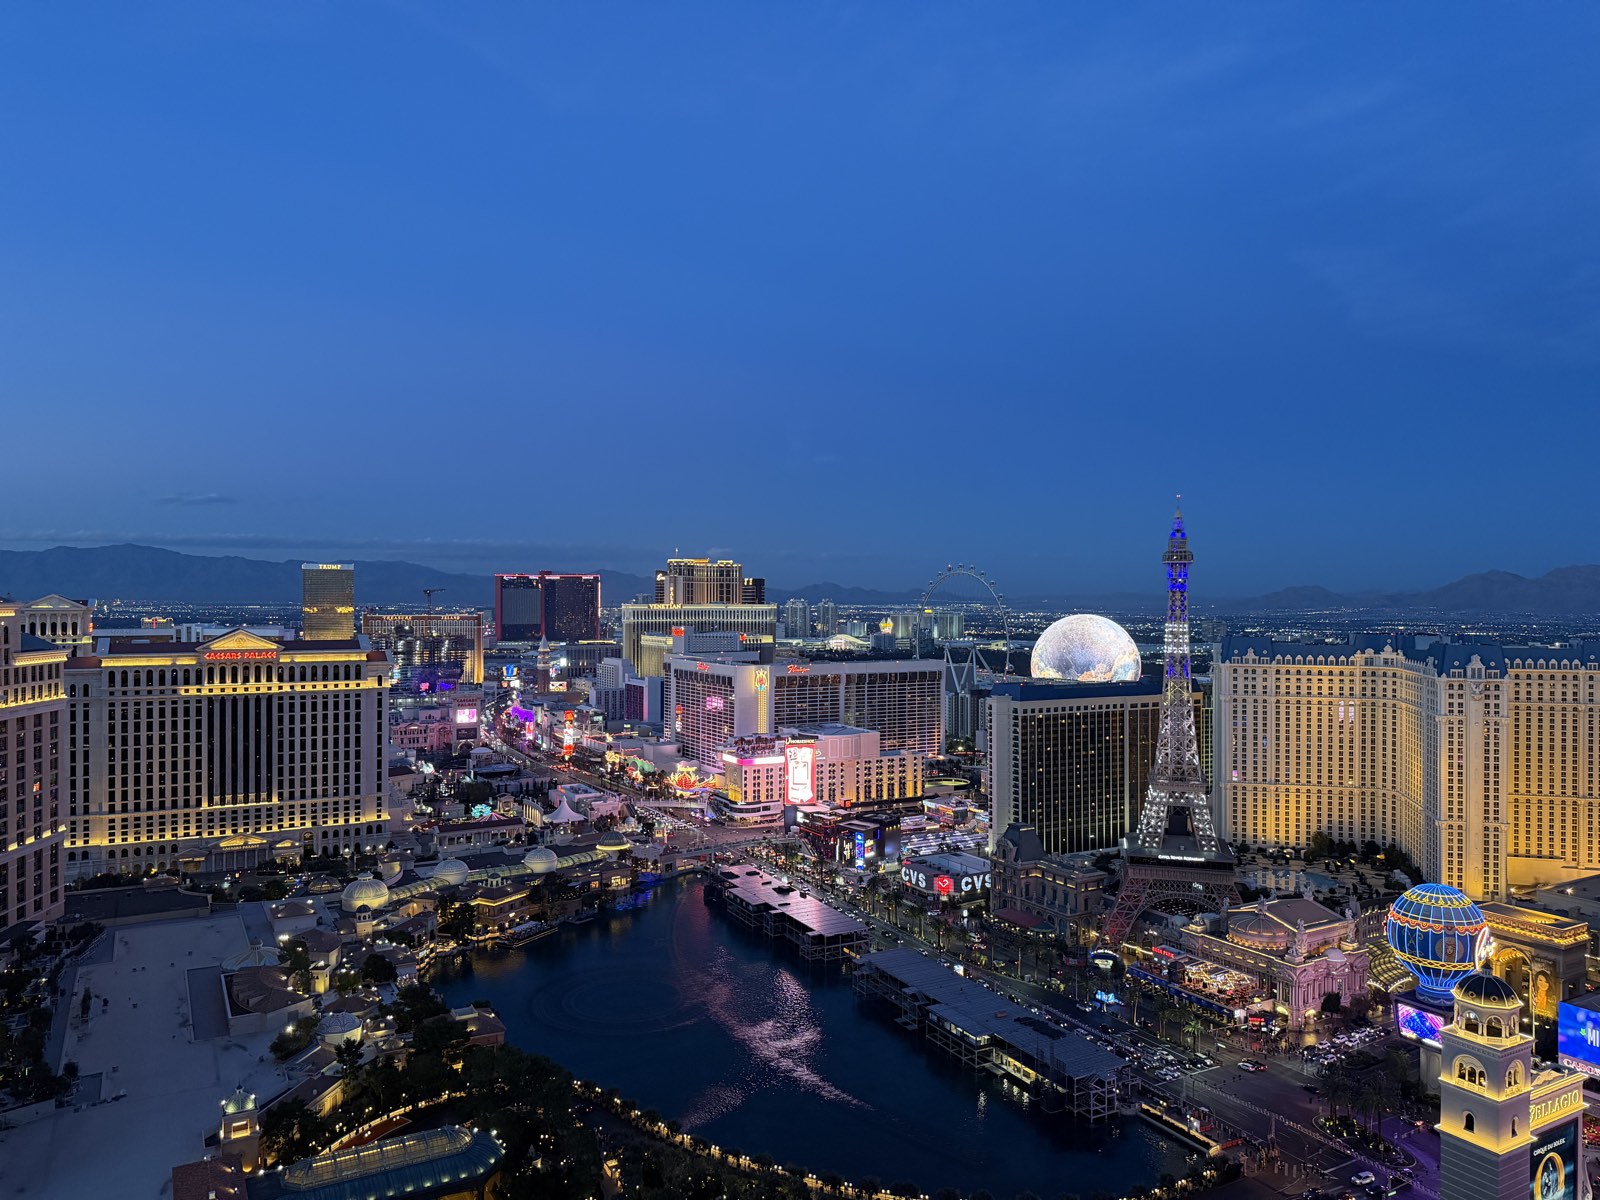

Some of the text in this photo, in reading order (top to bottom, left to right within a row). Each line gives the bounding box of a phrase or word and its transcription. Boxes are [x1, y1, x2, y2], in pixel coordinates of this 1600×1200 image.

[203, 651, 277, 660] CAESARS PALACE
[901, 866, 927, 888] CVS
[961, 873, 991, 892] CVS
